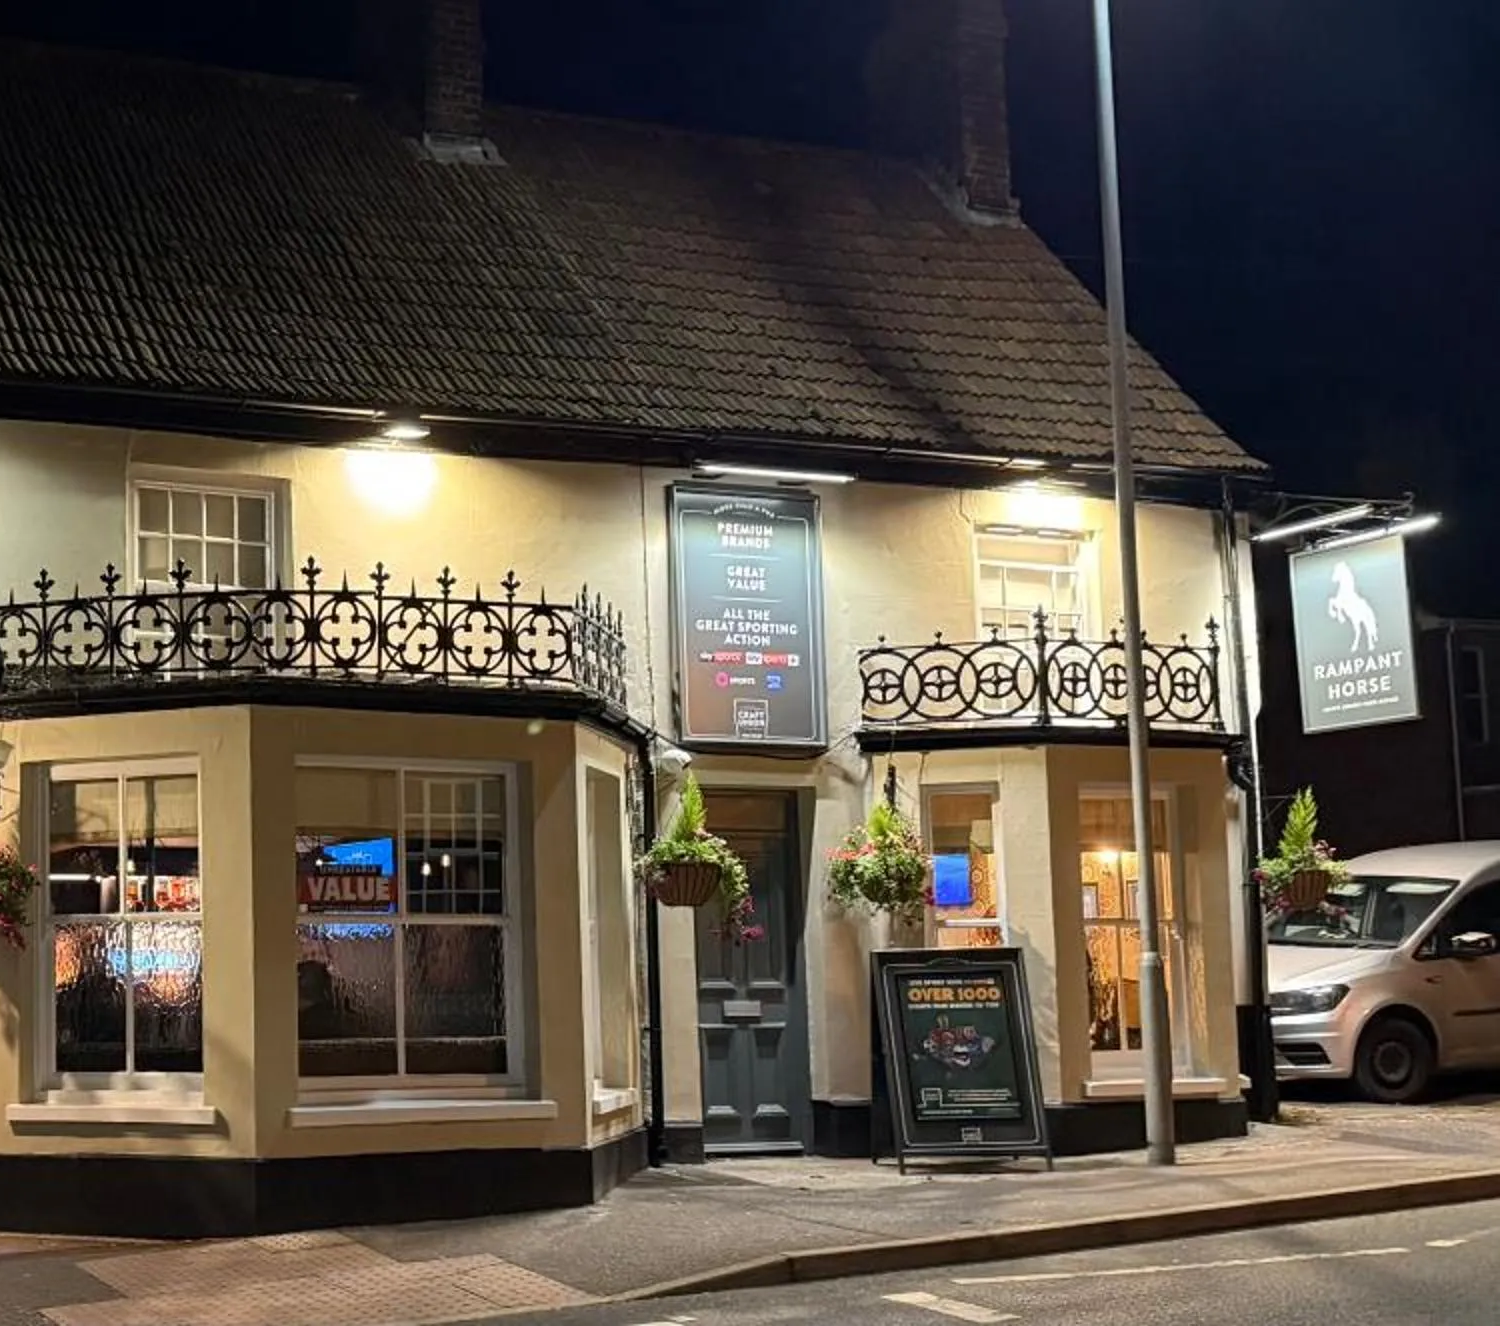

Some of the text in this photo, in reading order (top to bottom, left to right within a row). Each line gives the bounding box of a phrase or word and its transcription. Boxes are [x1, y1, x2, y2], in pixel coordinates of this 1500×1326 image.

[717, 523, 774, 537] PREMIUM
[722, 535, 771, 550] BRANDS
[726, 565, 766, 578] GREAT
[726, 578, 767, 592] VALUE
[723, 607, 771, 621] ALL THE
[695, 619, 798, 635] GREAT SPORTING
[723, 633, 771, 647] ACTION
[1313, 650, 1403, 681] RAMPANT
[1328, 675, 1392, 700] HORSE
[307, 876, 390, 901] VALUE
[908, 985, 1001, 1002] OVER 1000
